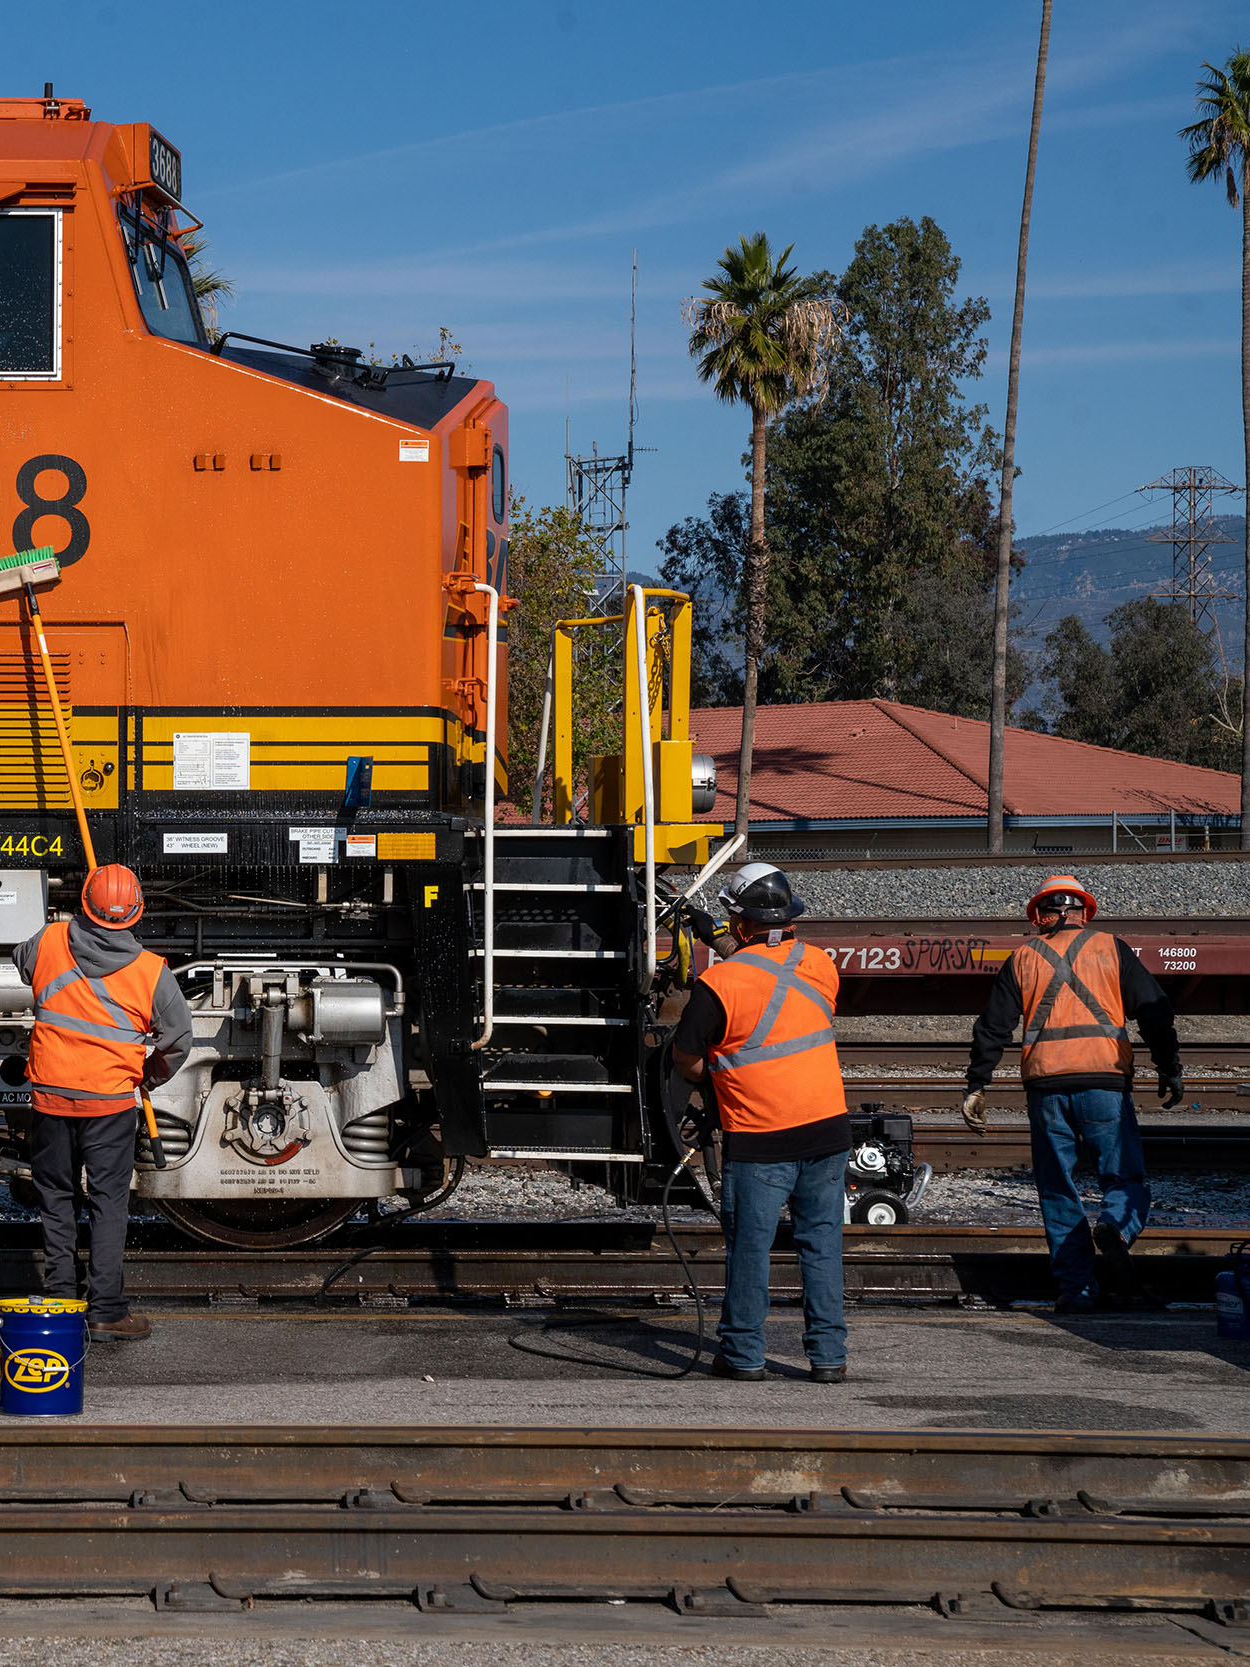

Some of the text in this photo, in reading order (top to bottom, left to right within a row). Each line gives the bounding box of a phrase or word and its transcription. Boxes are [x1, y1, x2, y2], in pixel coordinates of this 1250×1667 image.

[152, 138, 178, 194] 3688
[424, 885, 439, 908] F
[1158, 948, 1197, 957] 146800
[1164, 961, 1196, 970] 73200
[1, 1093, 31, 1103] AC MO
